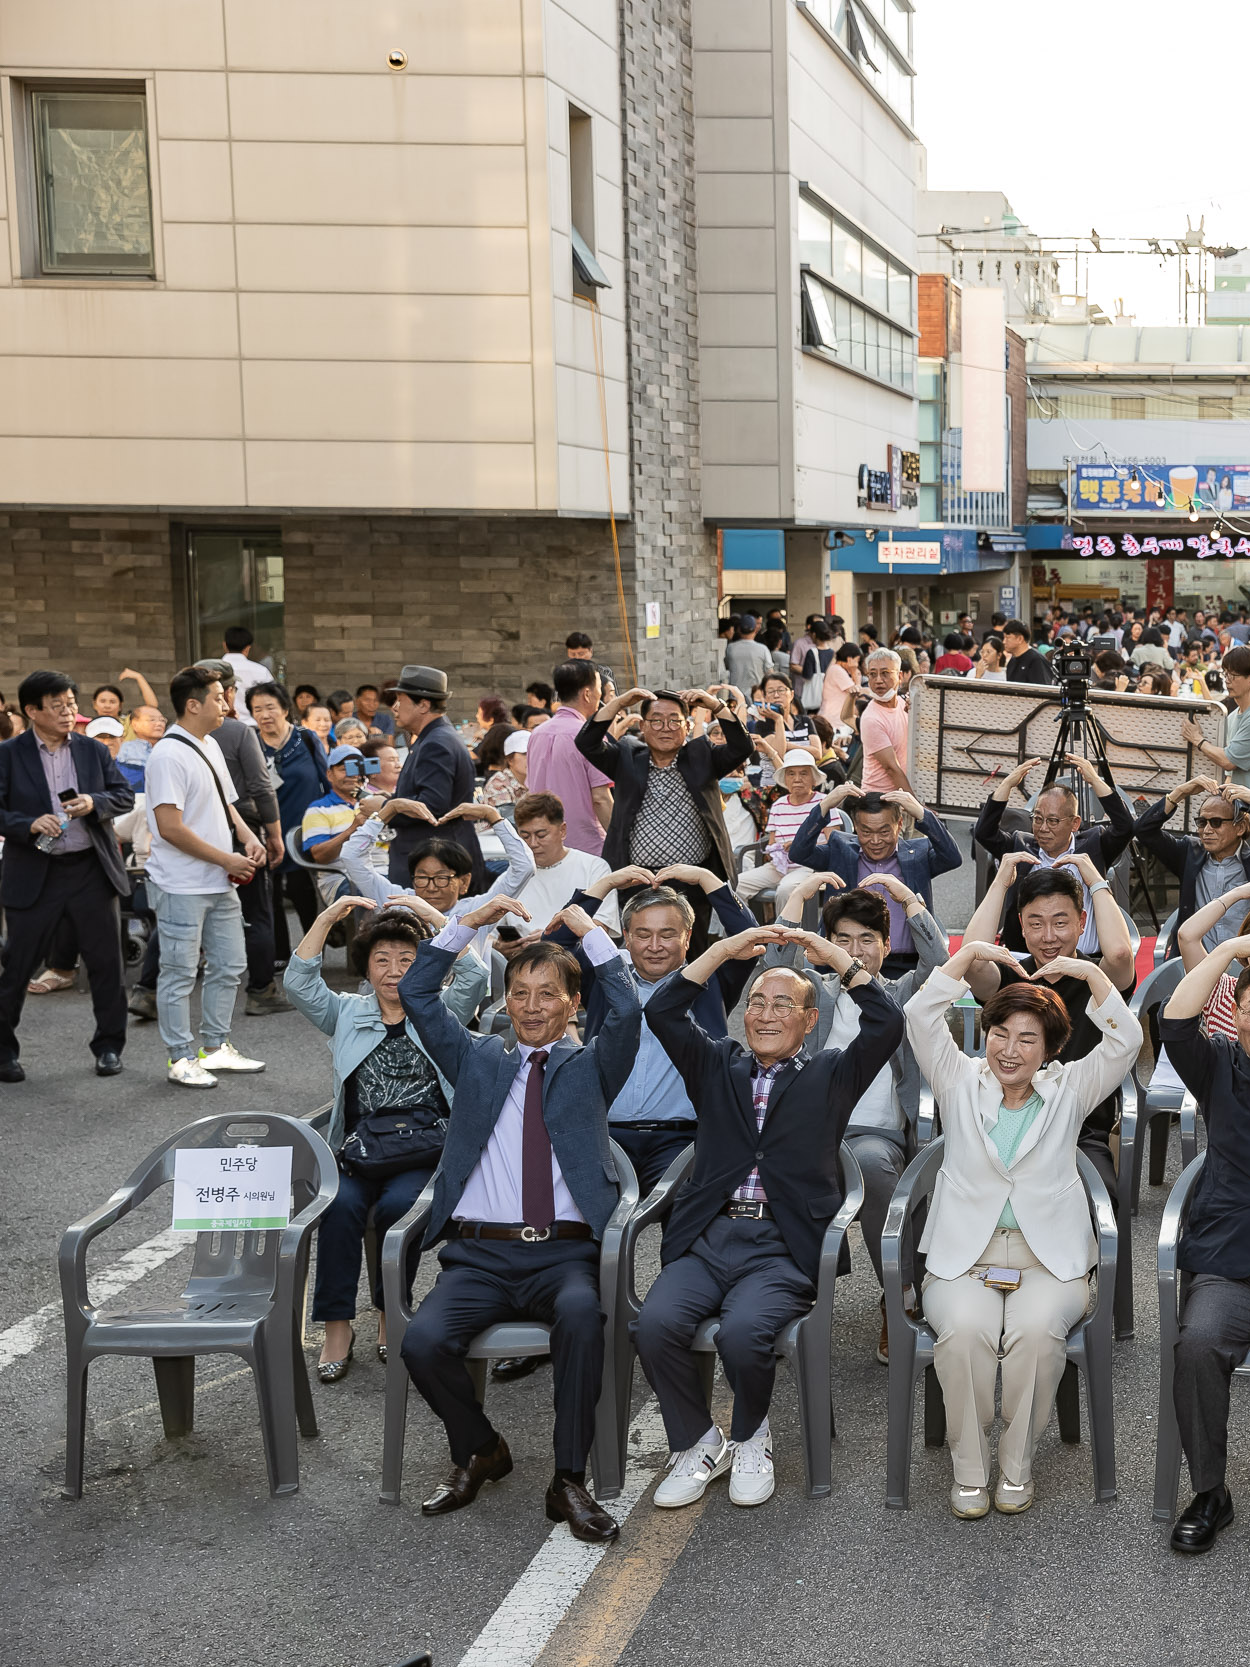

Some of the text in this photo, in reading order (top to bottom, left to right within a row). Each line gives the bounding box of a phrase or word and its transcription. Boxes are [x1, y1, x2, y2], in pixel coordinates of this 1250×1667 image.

[882, 546, 938, 559] 주차관리실
[220, 1156, 258, 1172] 민주당
[196, 1187, 275, 1203] 전병주 시의원님
